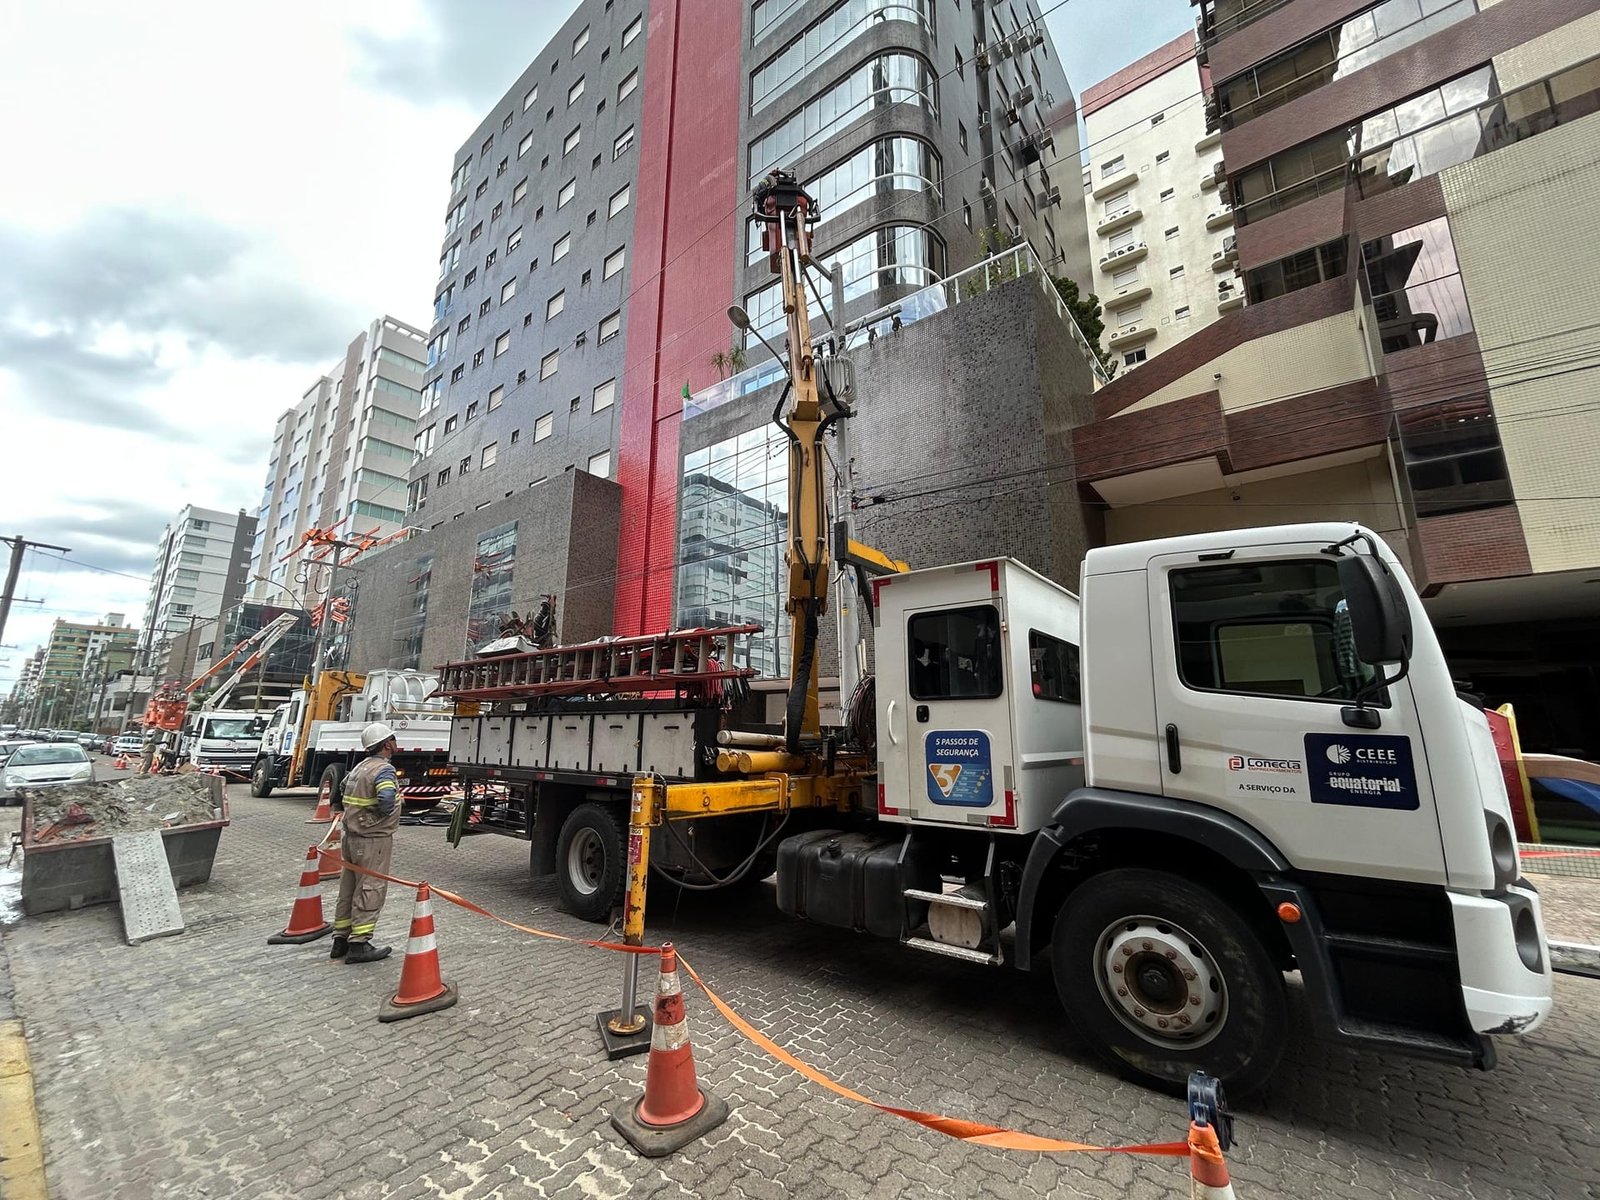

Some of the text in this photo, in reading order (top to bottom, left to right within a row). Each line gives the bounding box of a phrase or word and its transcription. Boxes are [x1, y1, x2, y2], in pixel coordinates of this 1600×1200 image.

[936, 748, 979, 757] SEGURANÇA
[1355, 748, 1396, 760] CEEE
[1247, 758, 1301, 769] Conecta
[1246, 784, 1281, 793] SERVIÇO
[1329, 776, 1401, 792] equatorial
